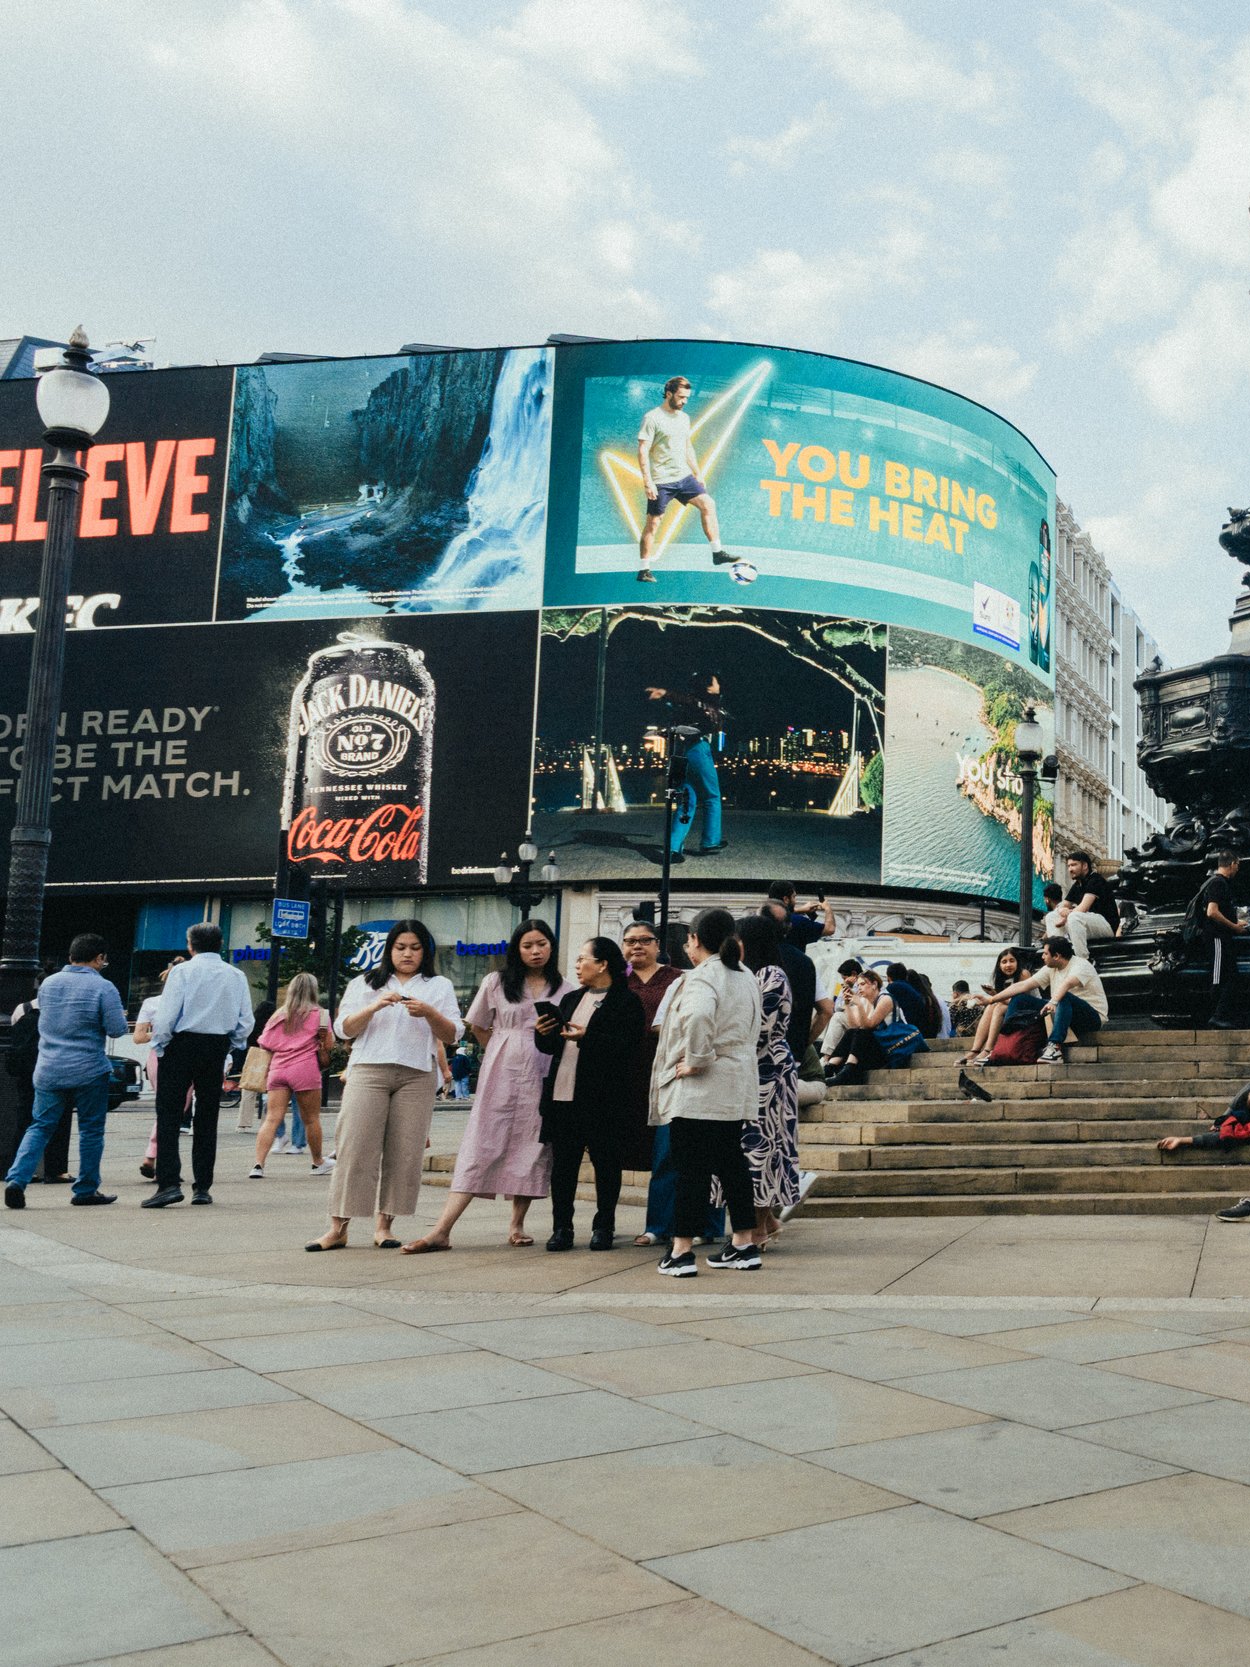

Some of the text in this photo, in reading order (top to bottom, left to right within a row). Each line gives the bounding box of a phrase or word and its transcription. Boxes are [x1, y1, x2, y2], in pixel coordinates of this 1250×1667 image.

[762, 438, 998, 530] YOU BRING
[760, 479, 970, 555] THE HEAT
[81, 706, 213, 736] READY
[300, 683, 348, 736] JACK
[351, 725, 372, 733] OLD
[53, 743, 98, 769] BE
[111, 740, 188, 767] THE
[341, 752, 380, 762] BRAND
[102, 770, 251, 801] MATCH.
[310, 784, 363, 793] TENNESSEE
[288, 804, 424, 863] Coca-Cola
[457, 940, 508, 956] beaut
